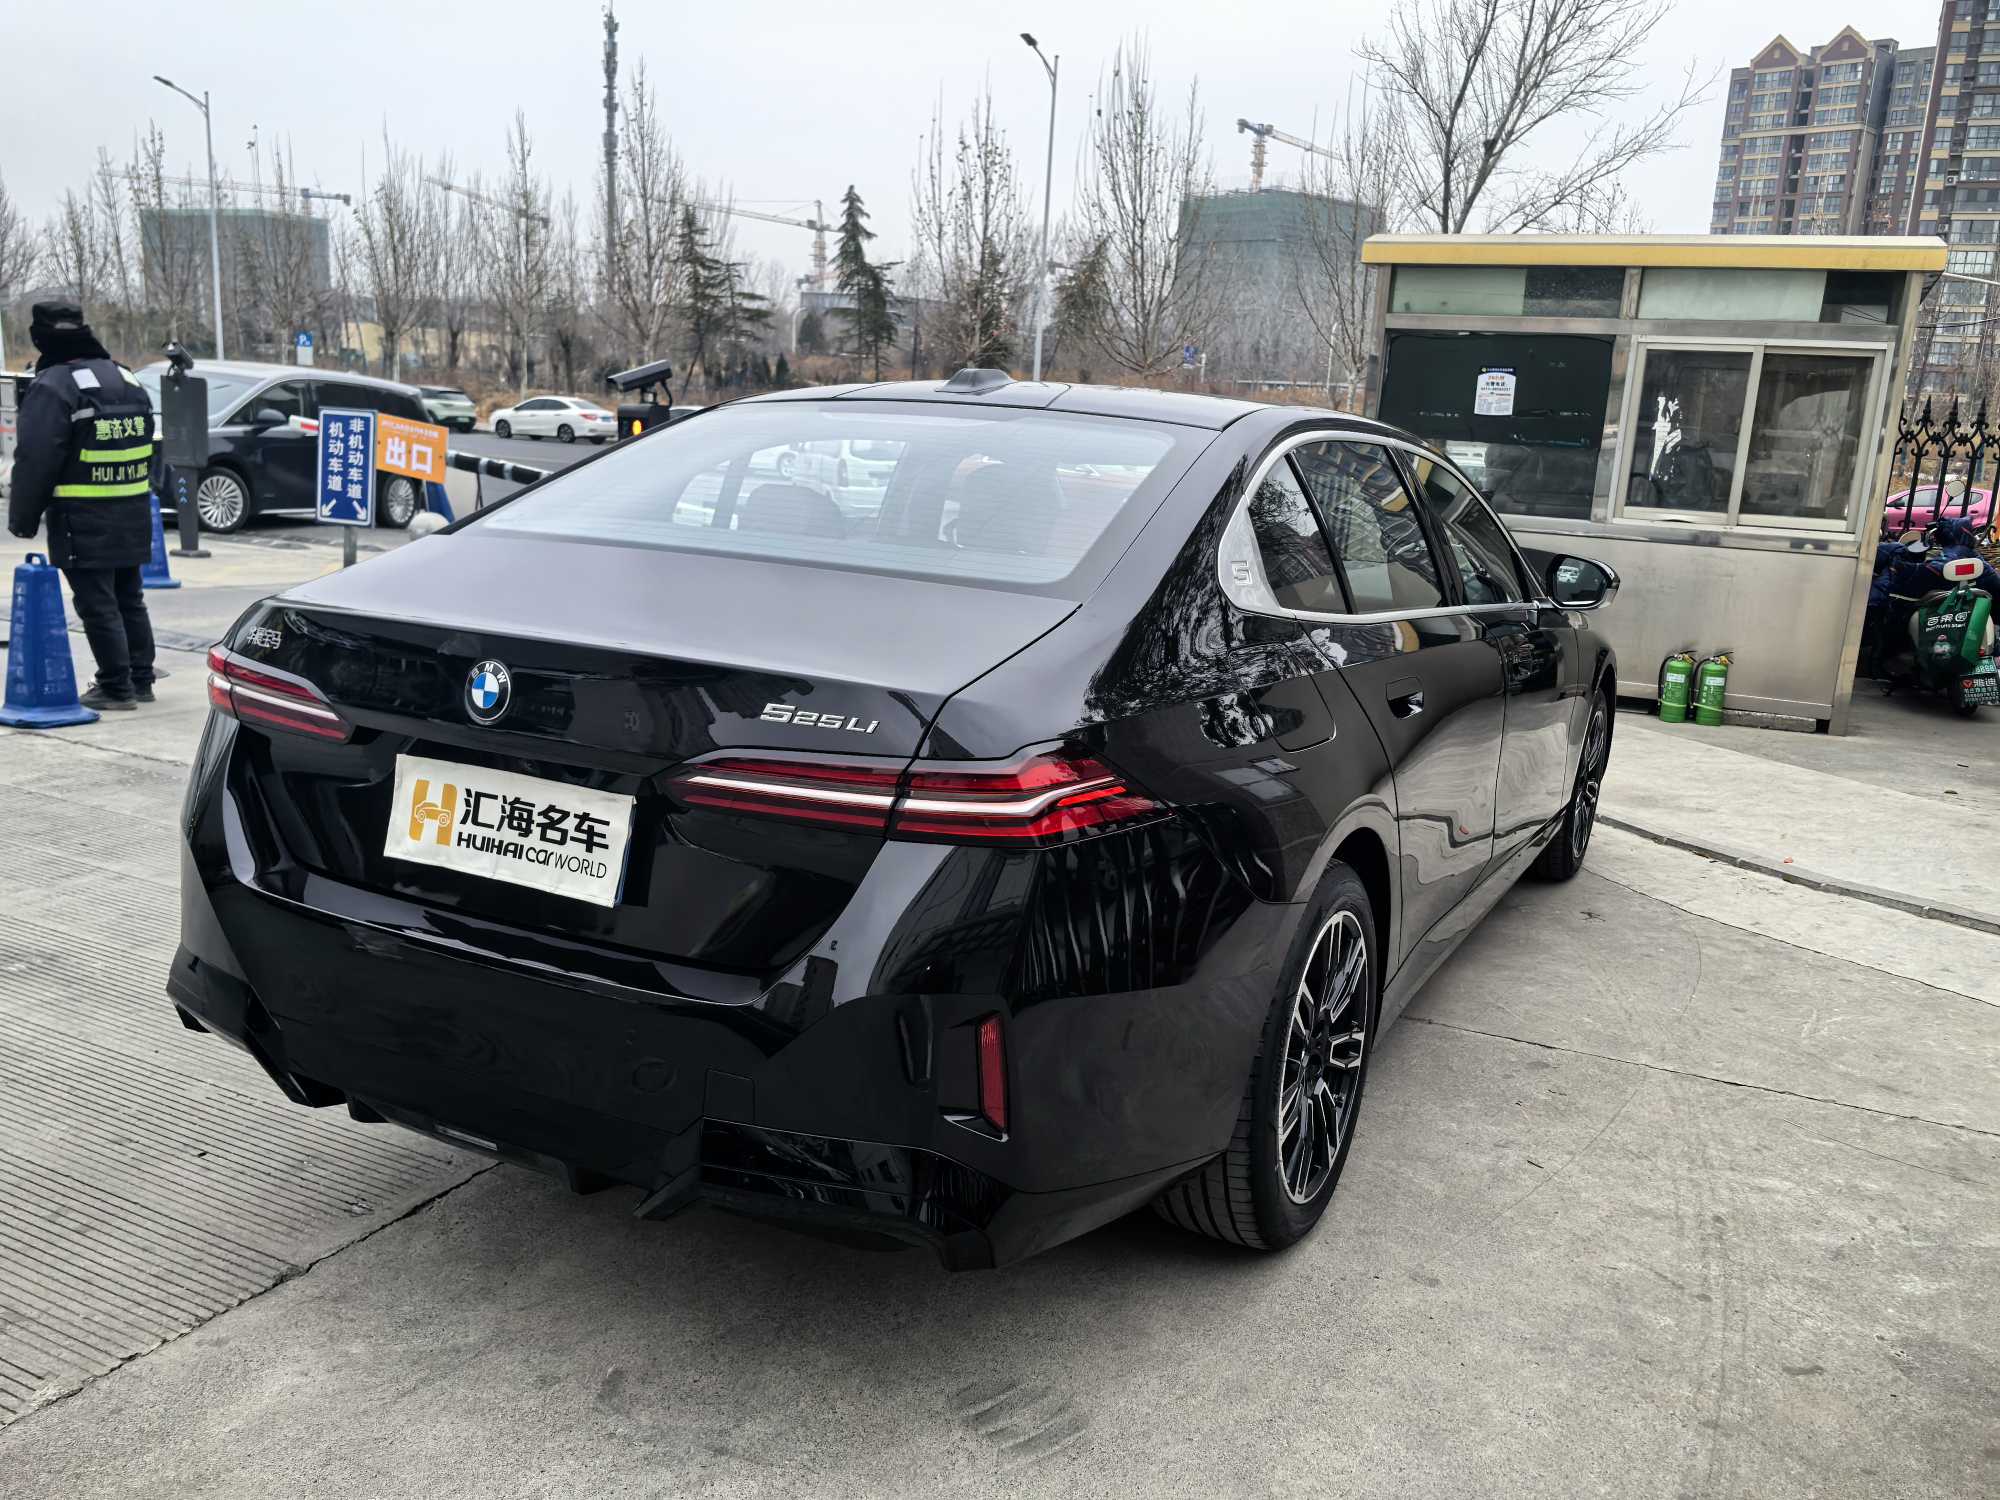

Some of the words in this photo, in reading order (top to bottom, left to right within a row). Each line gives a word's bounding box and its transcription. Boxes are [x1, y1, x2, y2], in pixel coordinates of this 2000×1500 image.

[94, 416, 145, 440] 惠济义警
[91, 466, 114, 481] HUI
[116, 465, 125, 481] JI
[127, 463, 136, 480] YI
[327, 421, 345, 492] 机动车道
[346, 417, 365, 500] 非机动车道
[385, 435, 433, 475] 出口
[471, 663, 507, 684] BMW
[760, 702, 880, 735] 525Li
[459, 787, 611, 854] 汇海名车
